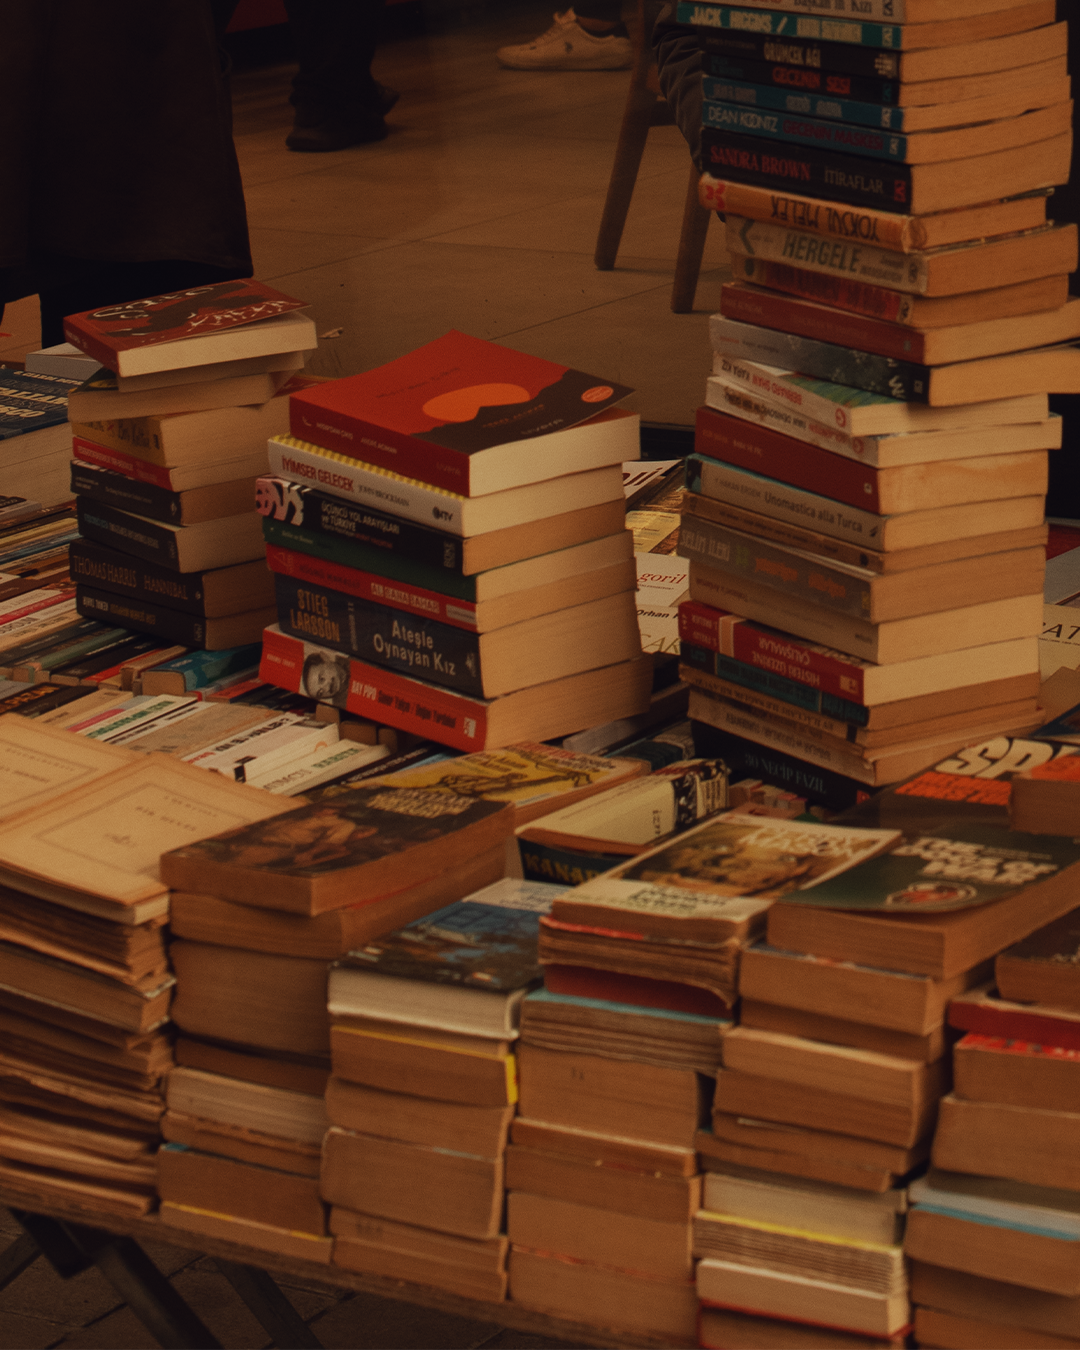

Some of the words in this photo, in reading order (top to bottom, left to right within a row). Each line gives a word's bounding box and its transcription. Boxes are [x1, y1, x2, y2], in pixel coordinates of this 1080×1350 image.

[708, 106, 738, 125] DEAN
[710, 144, 759, 172] SANDRA
[761, 158, 811, 182] BROWN
[770, 196, 820, 229] MELEK
[826, 207, 880, 242] YOKSUL
[782, 232, 859, 273] HERGELE
[281, 455, 317, 481] İYİMSER
[318, 469, 354, 493] GELECEK
[764, 491, 817, 519] Unomastica
[818, 508, 835, 524] alla
[836, 513, 863, 533] Turca
[73, 555, 106, 579] THOMAS
[106, 563, 138, 588] HARRIS
[143, 575, 189, 600] HANNIBAL
[297, 588, 329, 617] STIEG
[290, 608, 341, 642] LARSSON
[391, 619, 434, 650] Ateşle
[373, 633, 431, 668] Oynayan
[433, 653, 457, 677] Kız
[752, 651, 787, 676] ÜZERİNE
[758, 637, 811, 666] ÇALIŞMALAR
[788, 665, 821, 687] HİSTERİ
